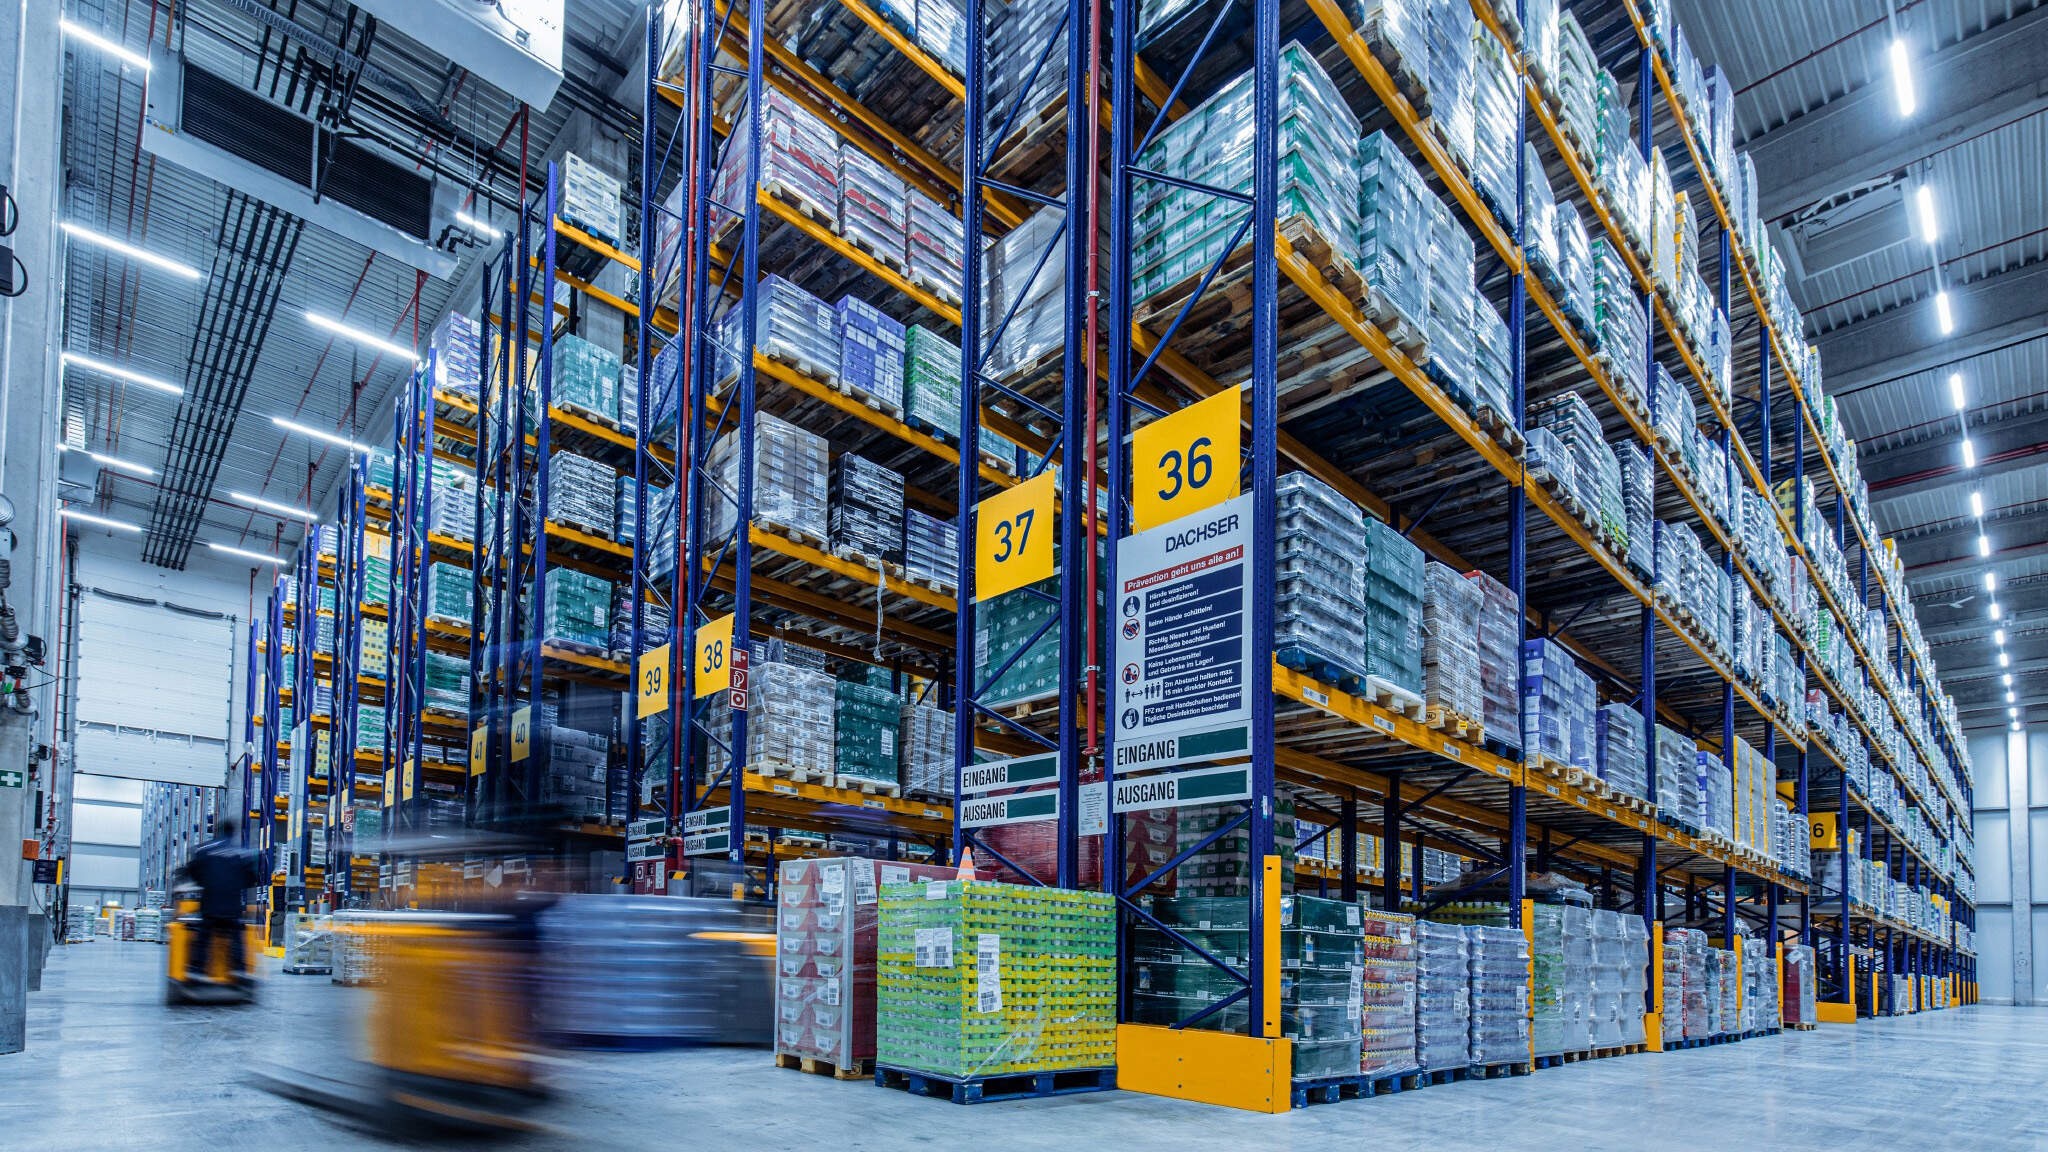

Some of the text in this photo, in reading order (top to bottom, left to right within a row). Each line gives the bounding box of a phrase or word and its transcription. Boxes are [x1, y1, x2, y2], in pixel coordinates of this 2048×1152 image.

[1158, 436, 1213, 501] 36
[993, 508, 1035, 563] 37
[1165, 513, 1240, 554] DACHSER
[1127, 548, 1240, 591] Prävention geht uns alle an!
[1149, 582, 1194, 601] Hände waschen
[1149, 600, 1161, 609] und
[1164, 612, 1183, 624] Hände
[1189, 625, 1202, 636] und
[703, 639, 723, 674] 38
[644, 666, 662, 697] 39
[1174, 673, 1199, 686] Abstand
[514, 721, 526, 745] 40
[1116, 738, 1175, 766] EINGANG
[963, 766, 1006, 788] EINGANG
[1116, 780, 1175, 806] AUSGANG
[685, 814, 706, 828] EINGANG
[962, 801, 1005, 822] AUSGANG
[685, 837, 706, 851] AUSGANG
